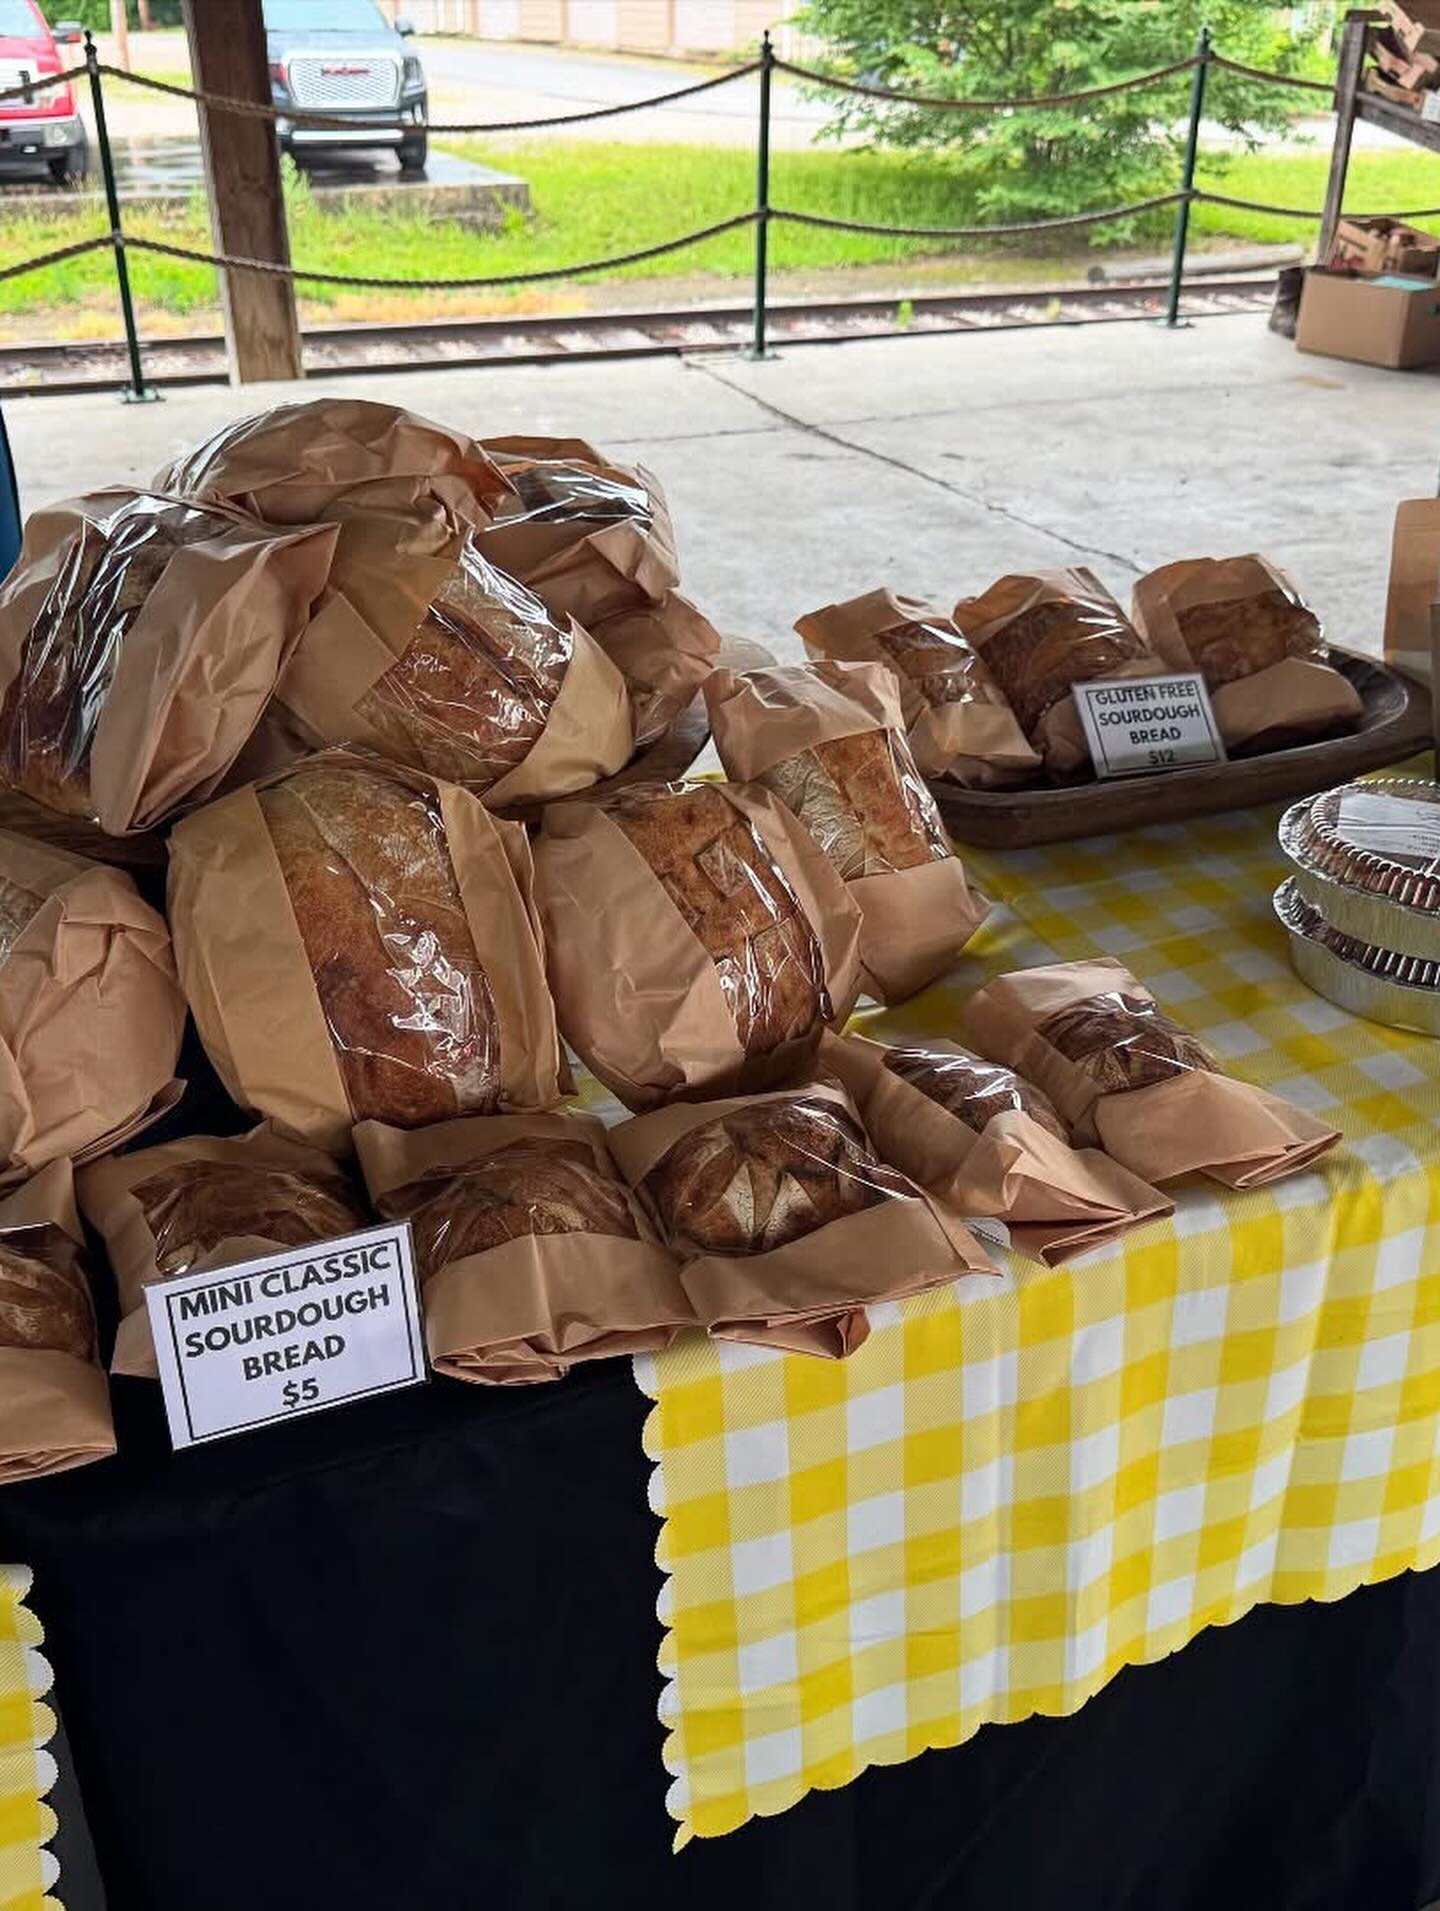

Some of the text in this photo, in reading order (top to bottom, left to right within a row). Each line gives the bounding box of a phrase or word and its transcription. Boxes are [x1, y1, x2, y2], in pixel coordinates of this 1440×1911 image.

[1095, 683, 1196, 705] GLUTEN FREE
[1098, 704, 1201, 726] SOURDOUGH
[1129, 727, 1182, 745] BREAD
[179, 1246, 391, 1320] MINI CLASSIC
[185, 1284, 390, 1358] SOURDOUGH
[242, 1334, 346, 1381] BREAD
[282, 1377, 319, 1408] $5
